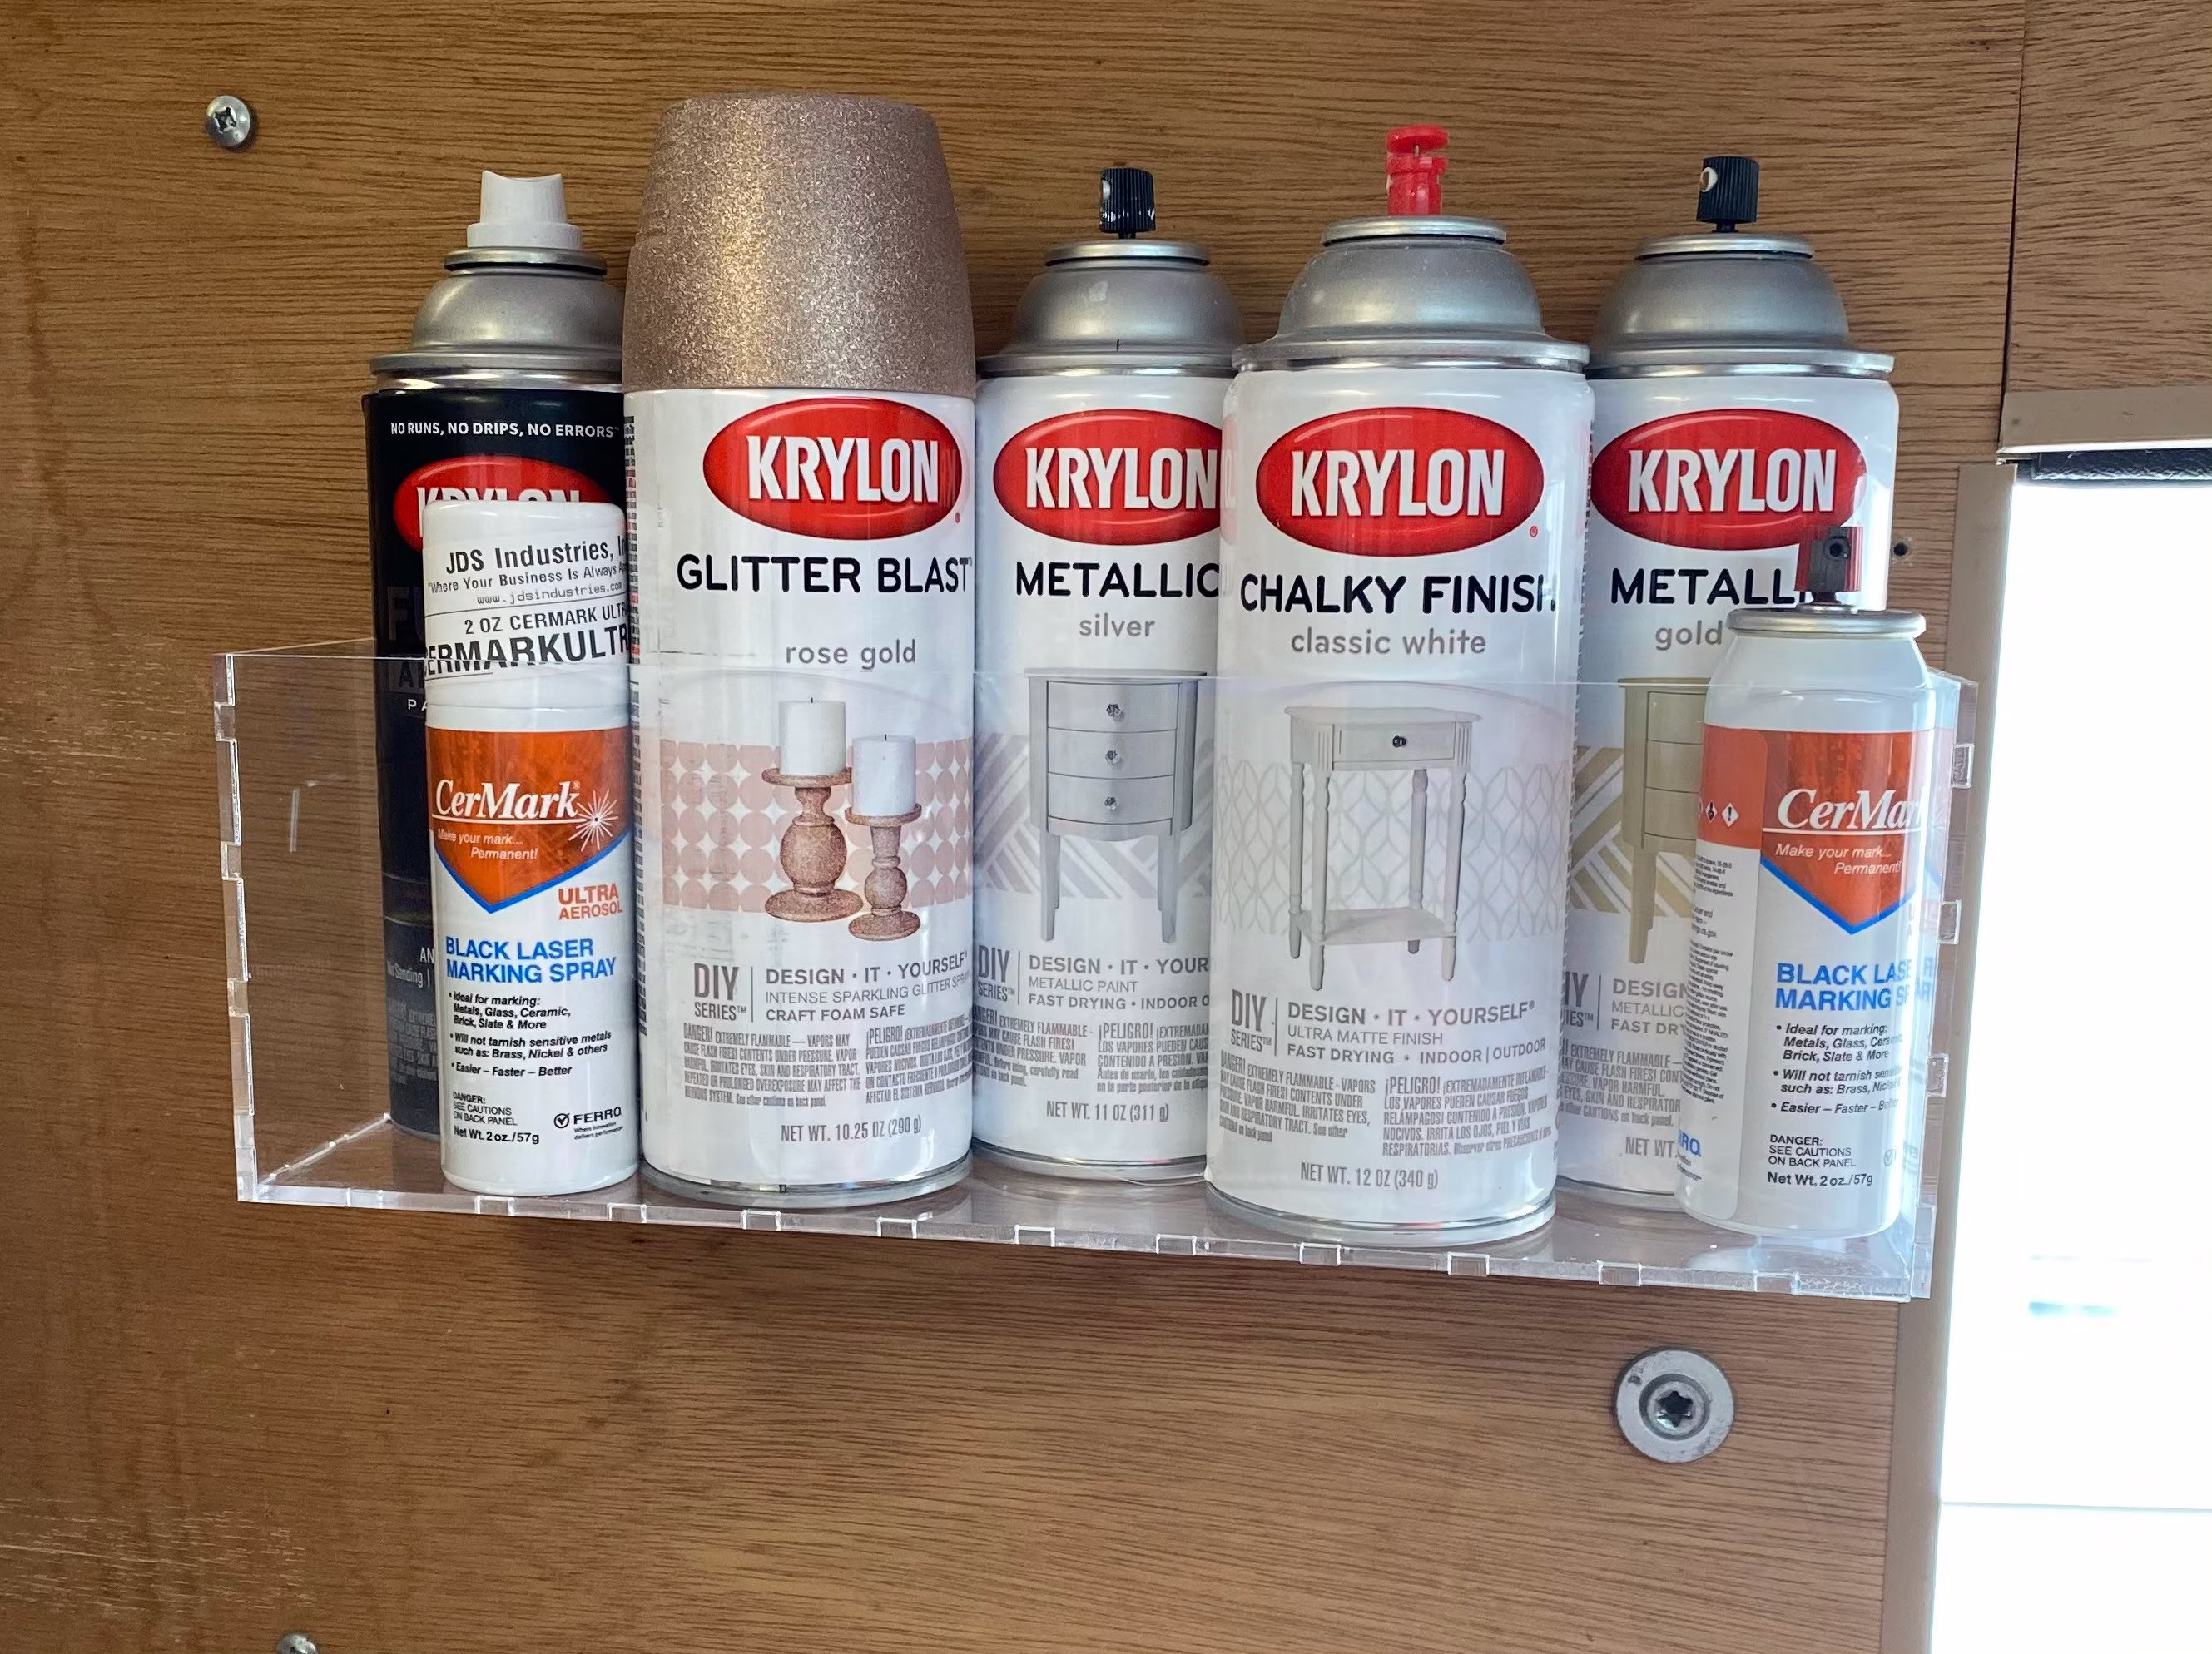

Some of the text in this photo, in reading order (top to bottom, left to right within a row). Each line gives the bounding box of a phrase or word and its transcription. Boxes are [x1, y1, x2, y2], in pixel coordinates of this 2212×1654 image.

[391, 423, 405, 435] NO
[408, 422, 444, 436] RUNS,
[448, 422, 469, 435] NO
[473, 423, 523, 437] DRIPS,
[528, 423, 552, 436] NO
[747, 435, 939, 503] KRYLON
[1025, 447, 1218, 509] KRYLON
[1291, 448, 1505, 517] KRYLON
[1629, 448, 1837, 513] KRYLON
[446, 549, 484, 575] JDS
[495, 540, 613, 569] Industries,
[463, 562, 617, 590] Your Business Is Always
[677, 553, 968, 593] GLITTER BLAST
[1016, 561, 1220, 598] METALLIC
[476, 582, 622, 605] www.jdsindustries.com
[1240, 574, 1407, 614] CHALKY
[464, 607, 598, 634] 2 OZ CERMARK
[1079, 612, 1155, 637] silver
[1292, 627, 1485, 655] classic white
[1655, 620, 1723, 651] gold
[786, 638, 916, 670] rose gold
[459, 833, 480, 845] your
[470, 846, 538, 860] Permanent!
[1775, 844, 1847, 860] Make your
[558, 883, 619, 905] ULTRA
[558, 901, 622, 920] AEROSOL
[445, 936, 593, 961] BLACK LASER
[446, 957, 617, 983] MARKING SPRAY
[978, 945, 1010, 983] DIY
[1029, 954, 1101, 974] DESIGN
[1120, 959, 1138, 975] IT
[693, 962, 740, 1001] DIY
[766, 968, 845, 985] DESIGN
[864, 966, 881, 983] IT
[1777, 963, 1867, 985] BLACK
[765, 991, 828, 1004] INTENSE
[831, 986, 910, 1003] SPARKLING
[911, 979, 951, 997] GLITTER
[1029, 976, 1138, 993] METALLIC PAINT
[454, 991, 540, 1008] Ideal for marking:
[1029, 993, 1198, 1010] FAST DRYING INDOOR
[1775, 988, 1892, 1011] MARKING
[453, 1003, 571, 1020] Metals, Glass, Ceramic,
[766, 1003, 905, 1023] CRAFT FOAM SAFE
[1232, 989, 1267, 1033] DIY
[1287, 1001, 1366, 1025] DESIGN
[1387, 1009, 1407, 1026] IT
[1612, 1001, 1684, 1018] METALLIC
[454, 1016, 547, 1029] Brick, Slate & More
[1611, 1019, 1651, 1034] FAST
[1785, 1023, 1887, 1037] Ideal for marking:
[470, 1031, 612, 1047] not tarnish sensitive metals
[1287, 1025, 1443, 1045] ULTRA MATTE FINISH
[1784, 1037, 1867, 1049] Metals, Glass,
[454, 1043, 608, 1061] such Brass, Nickel others
[1117, 1041, 1153, 1053] VAPORES
[1287, 1037, 1545, 1064] FAST DRYING INDOOR OUTDOOR
[1783, 1050, 1852, 1063] Brick, Slate
[1059, 1052, 1086, 1065] VAPOR
[456, 1062, 573, 1077] Easier Faster Better
[1783, 1069, 1872, 1081] Will not tarnish
[1342, 1077, 1376, 1094] VAPORS
[1780, 1083, 1869, 1096] such as: Brass,
[453, 1091, 486, 1105] DANGER:
[1290, 1088, 1363, 1108] CONTENTS UNDER
[1404, 1096, 1441, 1110] VAPORES
[453, 1101, 512, 1116] SEE CAUTIONS
[573, 1106, 622, 1125] FERRO
[1046, 1101, 1154, 1122] NET WT. 11 OZ (311
[1780, 1102, 1867, 1115] Easier Faster
[464, 1113, 517, 1126] BACK PANEL
[454, 1125, 468, 1137] Net
[781, 1117, 910, 1142] NET WT. 10.25 OZ (290
[1625, 1137, 1649, 1156] NET
[1770, 1134, 1823, 1146] DANGER:
[1769, 1146, 1851, 1156] SEE CAUTIONS
[1768, 1156, 1857, 1167] ON BACK PANEL
[1301, 1162, 1424, 1189] NET WT. 12 OZ (340
[1768, 1171, 1818, 1186] Net Wt.
